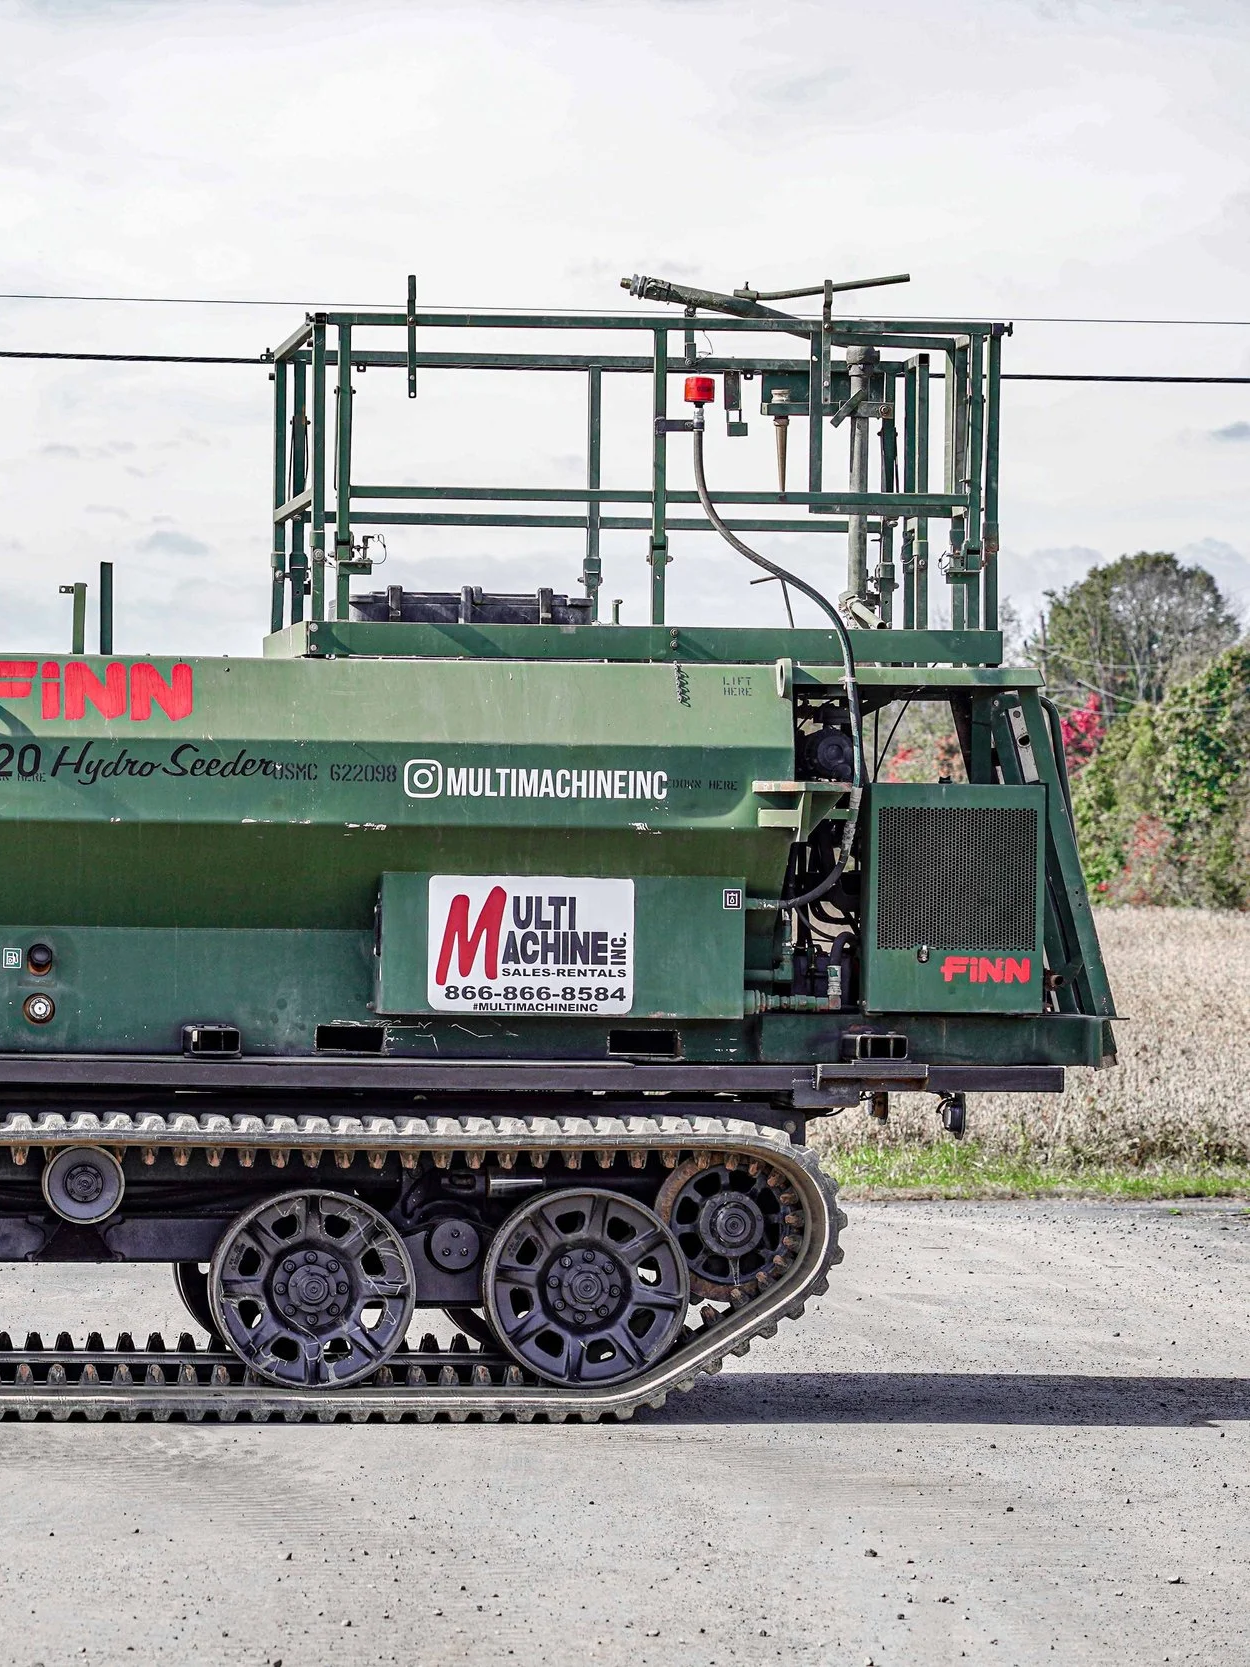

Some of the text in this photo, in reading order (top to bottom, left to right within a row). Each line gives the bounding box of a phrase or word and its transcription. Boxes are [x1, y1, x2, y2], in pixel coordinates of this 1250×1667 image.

[723, 676, 752, 686] LIFT
[723, 687, 752, 697] HERE
[51, 740, 160, 785] Hydro
[162, 743, 276, 777] Seeder
[330, 763, 398, 783] 622098
[447, 767, 668, 800] MULTIMACHINEINC
[708, 780, 739, 791] HERE
[501, 968, 627, 978] SALES-RENTALS
[444, 985, 627, 1002] 866-866-8584
[472, 1003, 599, 1013] #MULTIMACHINEINC
